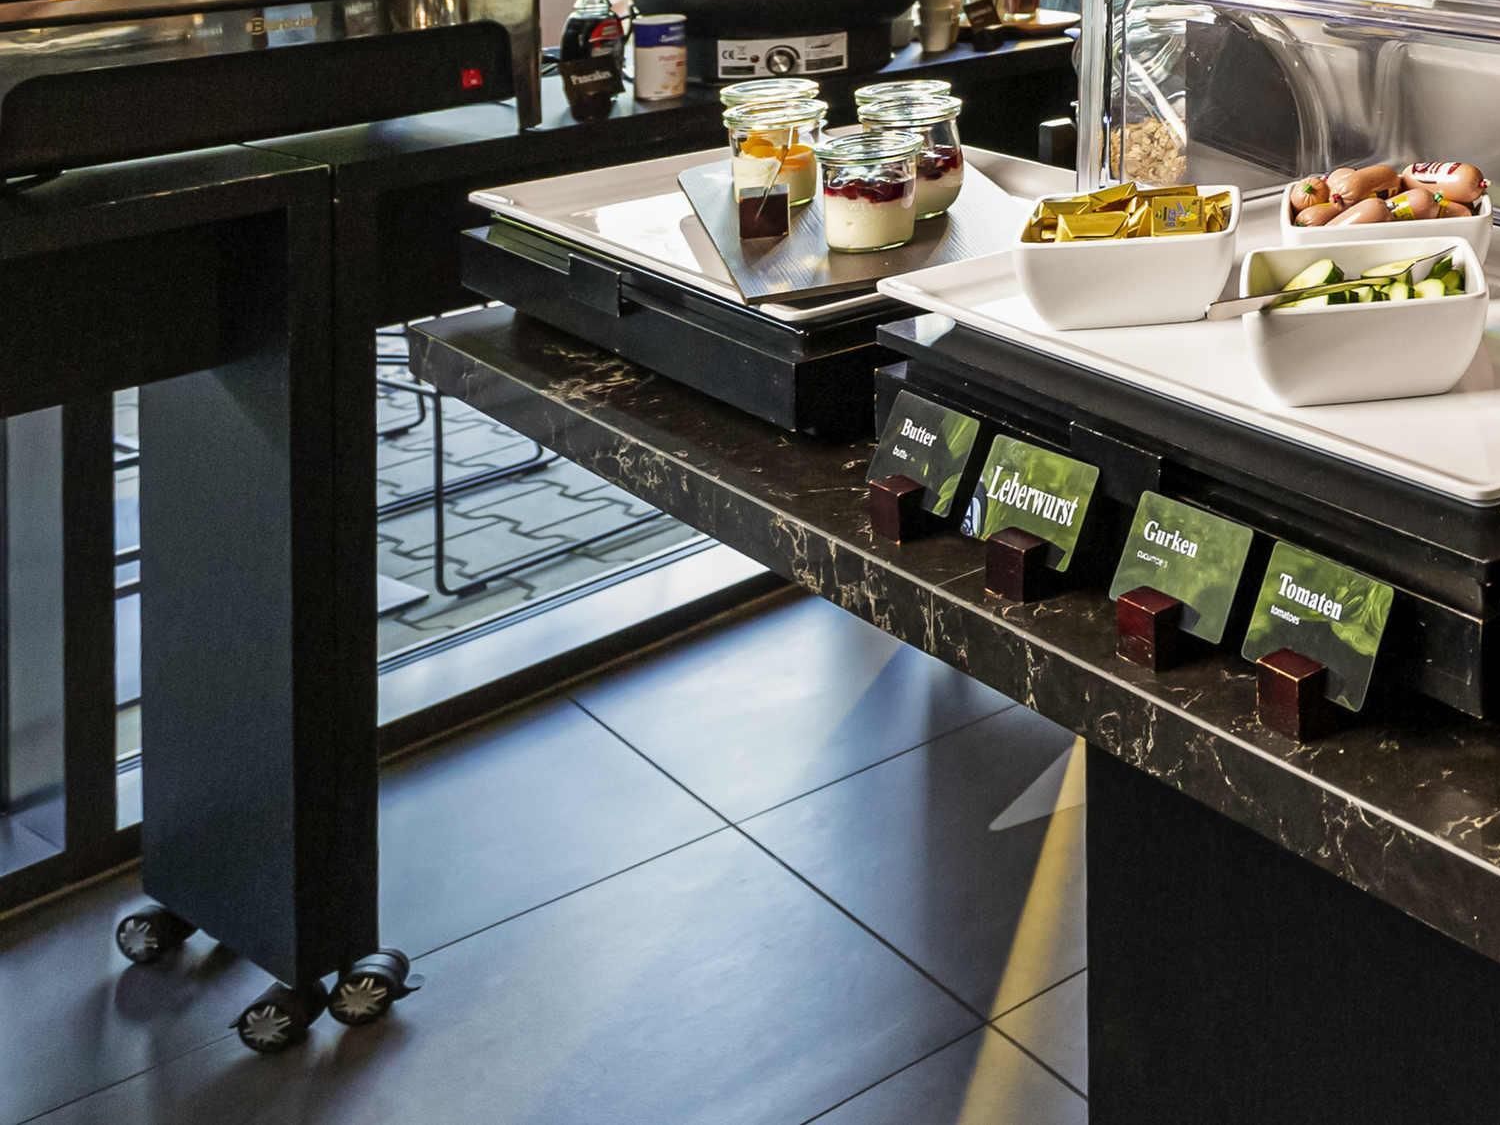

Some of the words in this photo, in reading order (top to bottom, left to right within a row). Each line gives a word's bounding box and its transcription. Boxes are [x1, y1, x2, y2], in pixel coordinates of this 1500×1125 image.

[900, 418, 938, 447] Butter
[986, 465, 1080, 527] Leberwurst
[1143, 520, 1199, 559] Gurken
[1270, 604, 1301, 625] tomatoes
[1278, 573, 1343, 621] Tomaten
